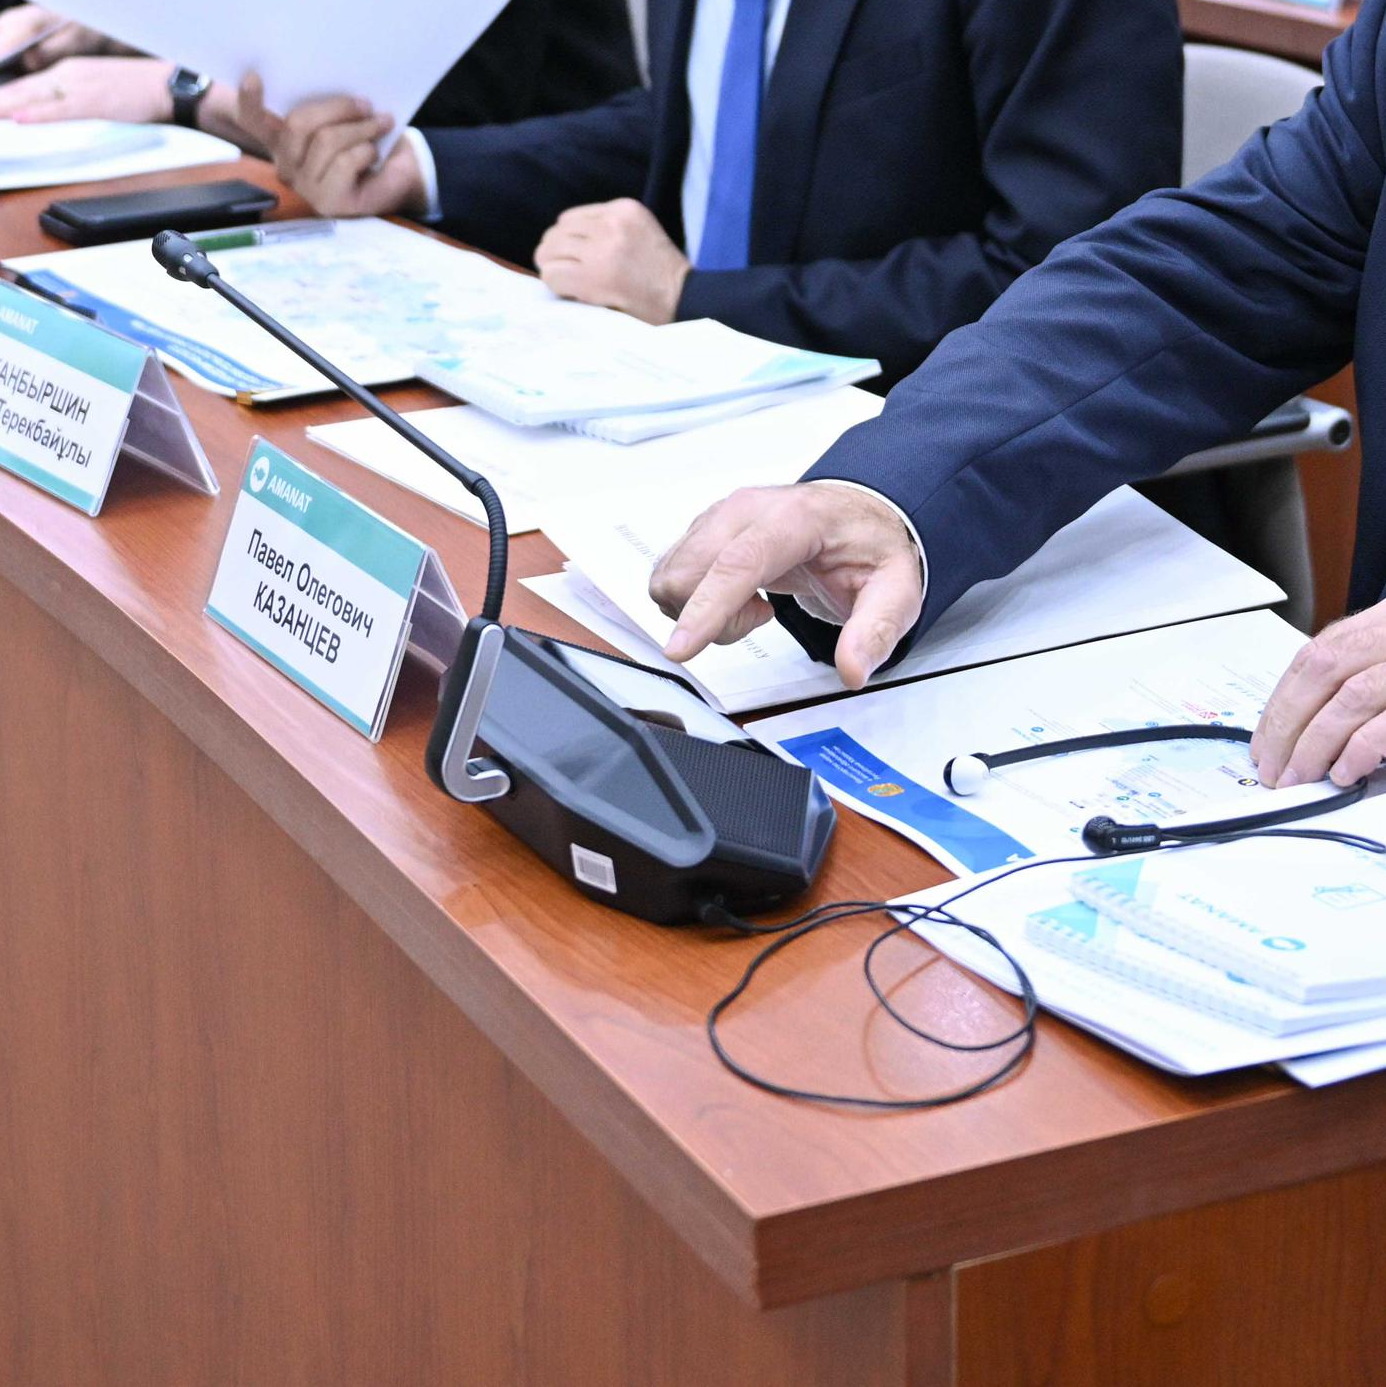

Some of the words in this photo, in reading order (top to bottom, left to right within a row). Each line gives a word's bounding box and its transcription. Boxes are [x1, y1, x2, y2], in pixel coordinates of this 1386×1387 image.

[267, 474, 313, 514] AMANAT
[247, 528, 295, 583] Павел
[296, 563, 374, 638] Олегович
[253, 581, 342, 664] КАЗАНЦЕВ
